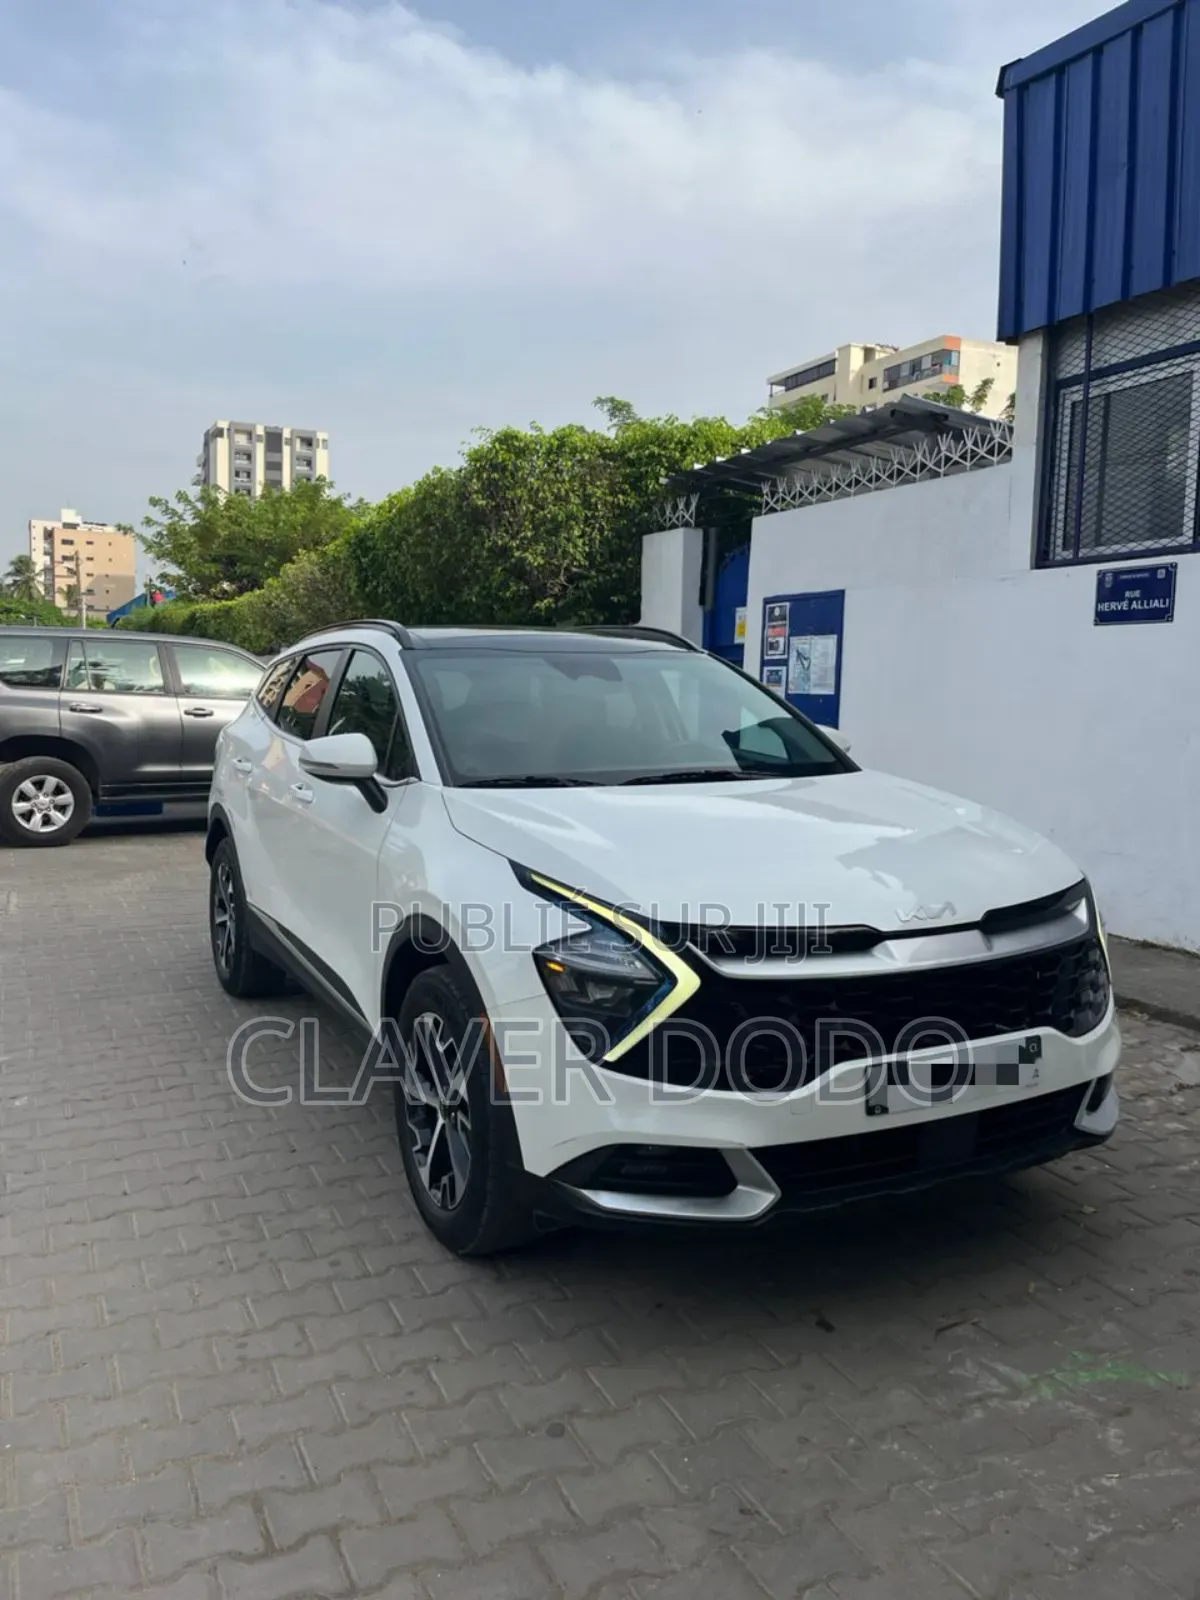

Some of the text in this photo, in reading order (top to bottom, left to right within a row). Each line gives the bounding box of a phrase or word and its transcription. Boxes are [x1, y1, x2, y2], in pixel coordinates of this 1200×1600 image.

[1124, 589, 1141, 598] RUE
[1097, 598, 1170, 612] HERVÉ ALLIALI
